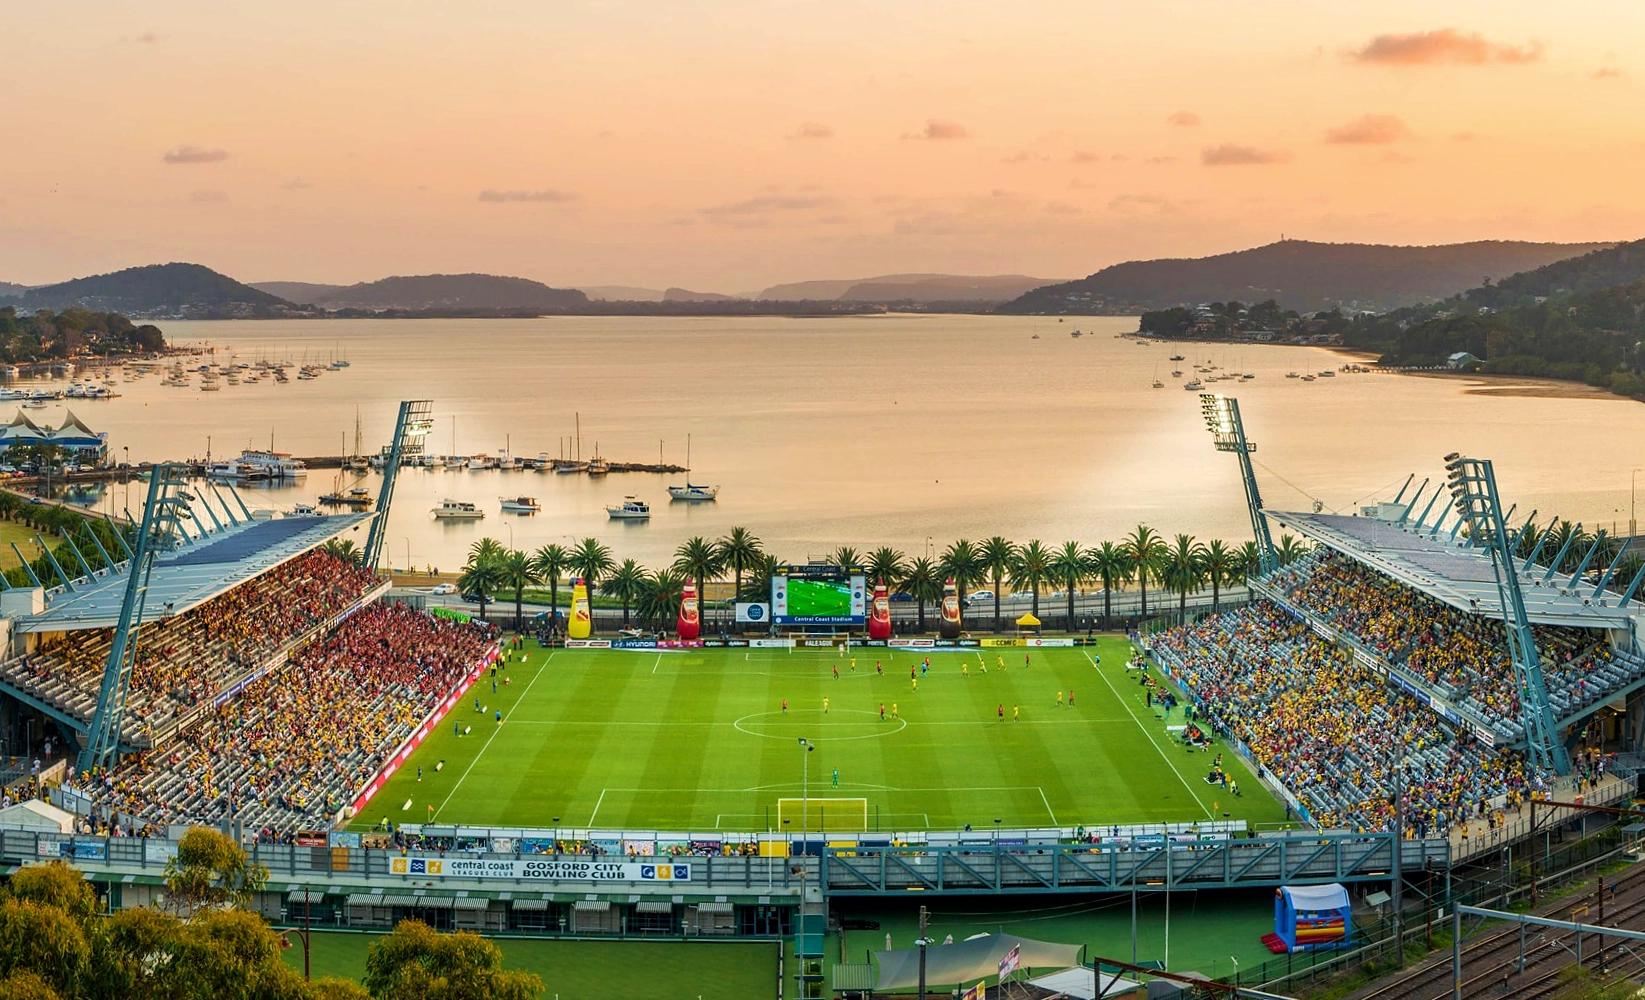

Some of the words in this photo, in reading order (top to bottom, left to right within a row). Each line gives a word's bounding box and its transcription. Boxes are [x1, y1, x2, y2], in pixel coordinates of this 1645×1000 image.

[451, 861, 486, 870] central
[488, 862, 514, 870] coast
[526, 862, 590, 871] GOSFORD
[594, 863, 623, 871] CITY
[523, 870, 588, 878] BOWLING
[591, 871, 625, 879] CLUB
